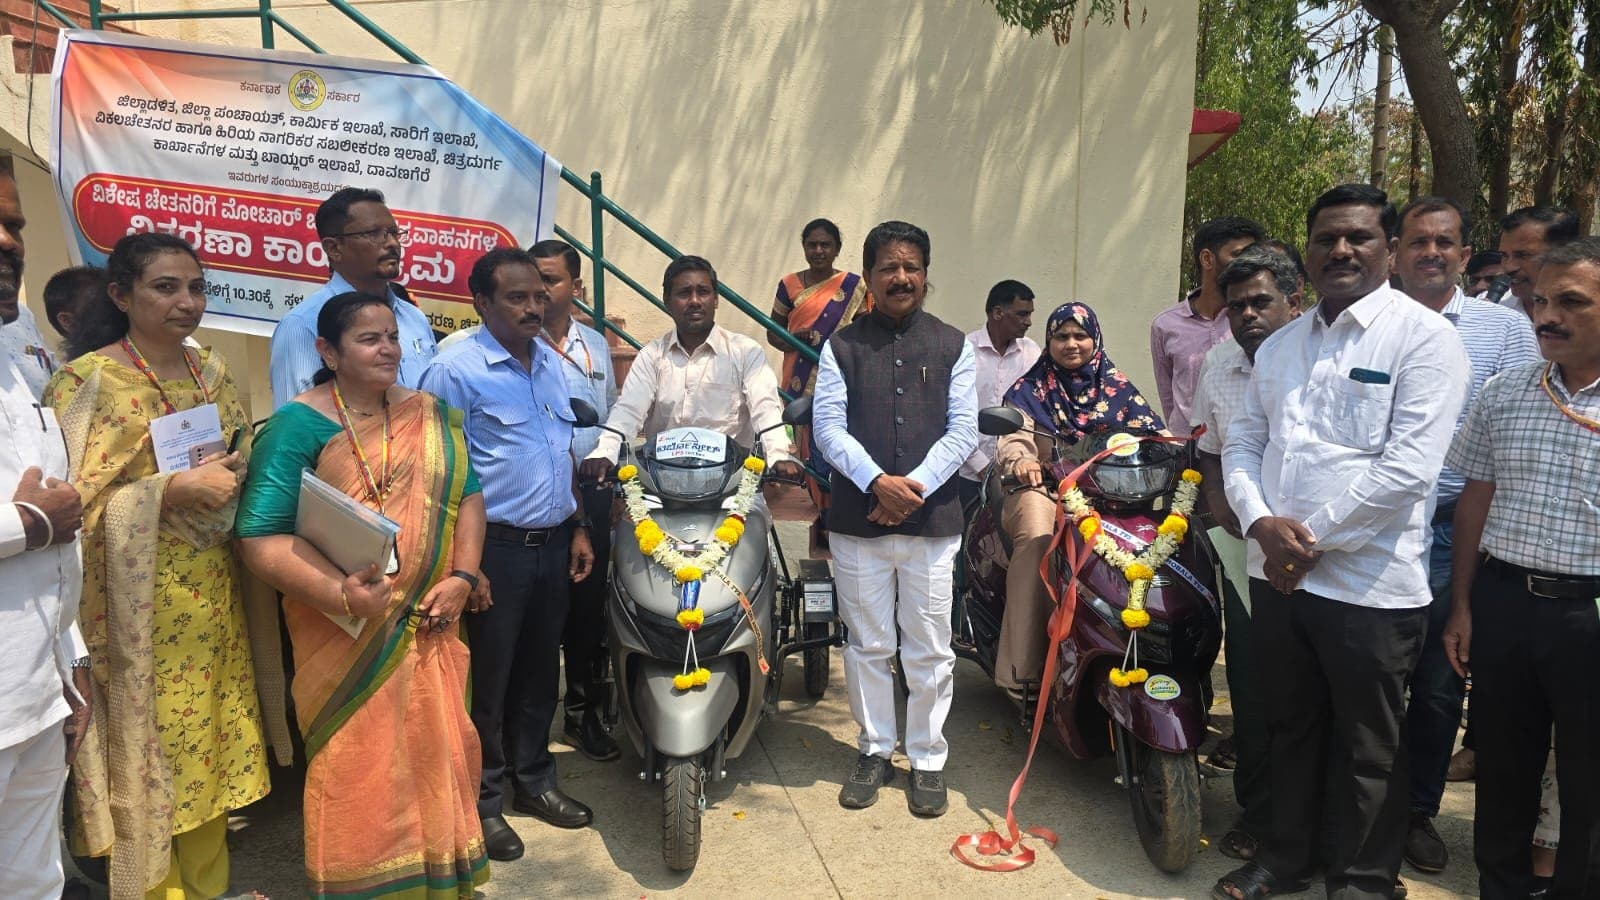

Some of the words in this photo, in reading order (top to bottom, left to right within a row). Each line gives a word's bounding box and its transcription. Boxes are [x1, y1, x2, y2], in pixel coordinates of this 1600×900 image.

[240, 81, 281, 95] ಕರ್ನಾಟಕ
[327, 91, 361, 103] ಸರ್ಕಾರ
[95, 111, 172, 132] ವಿಕಲಚೇತನರ
[175, 122, 212, 136] ಹಾಗೂ
[215, 125, 255, 141] ಹಿರಿಯ
[258, 130, 314, 148] ನಾಗರಿಕರ
[316, 137, 390, 156] ಸಬಲೀಕರಣ
[394, 148, 439, 165] ಇಲಾಖೆ,
[443, 152, 503, 171] ಚಿತ್ರದುರ್ಗ
[117, 95, 178, 114] ಜಿಲ್ಲಾಡಳಿತ,
[182, 102, 211, 121] ಜಿಲ್ಲಾ
[214, 105, 286, 127] ಪಂಚಾಯತ್,
[289, 115, 340, 130] ಕಾರ್ಮಿಕ
[342, 121, 386, 138] ಇಲಾಖೆ,
[390, 126, 430, 141] ಸಾರಿಗೆ
[432, 131, 479, 149] ಇಲಾಖೆ,
[153, 138, 226, 157] ಕಾರ್ಖಾನೆಗಳ
[229, 147, 259, 166] ಮತ್ತು
[261, 151, 315, 171] ಬಾಯ್ಲರ್
[317, 158, 363, 176] ಇಲಾಖೆ,
[367, 163, 430, 182] ದಾವಣಗೆರೆ
[92, 182, 141, 209] ವಿಶೇಷ
[145, 187, 217, 217] ಚೇತನರಿಗೆ
[221, 199, 302, 227] ಮೋಟಾರ್
[228, 171, 269, 184] ಇವರುಗಳ
[271, 175, 350, 194] ಸಂಯುಕ್ತಾಶ್ರಯದ
[232, 287, 274, 309] 10.30ಕ್ಕೆ
